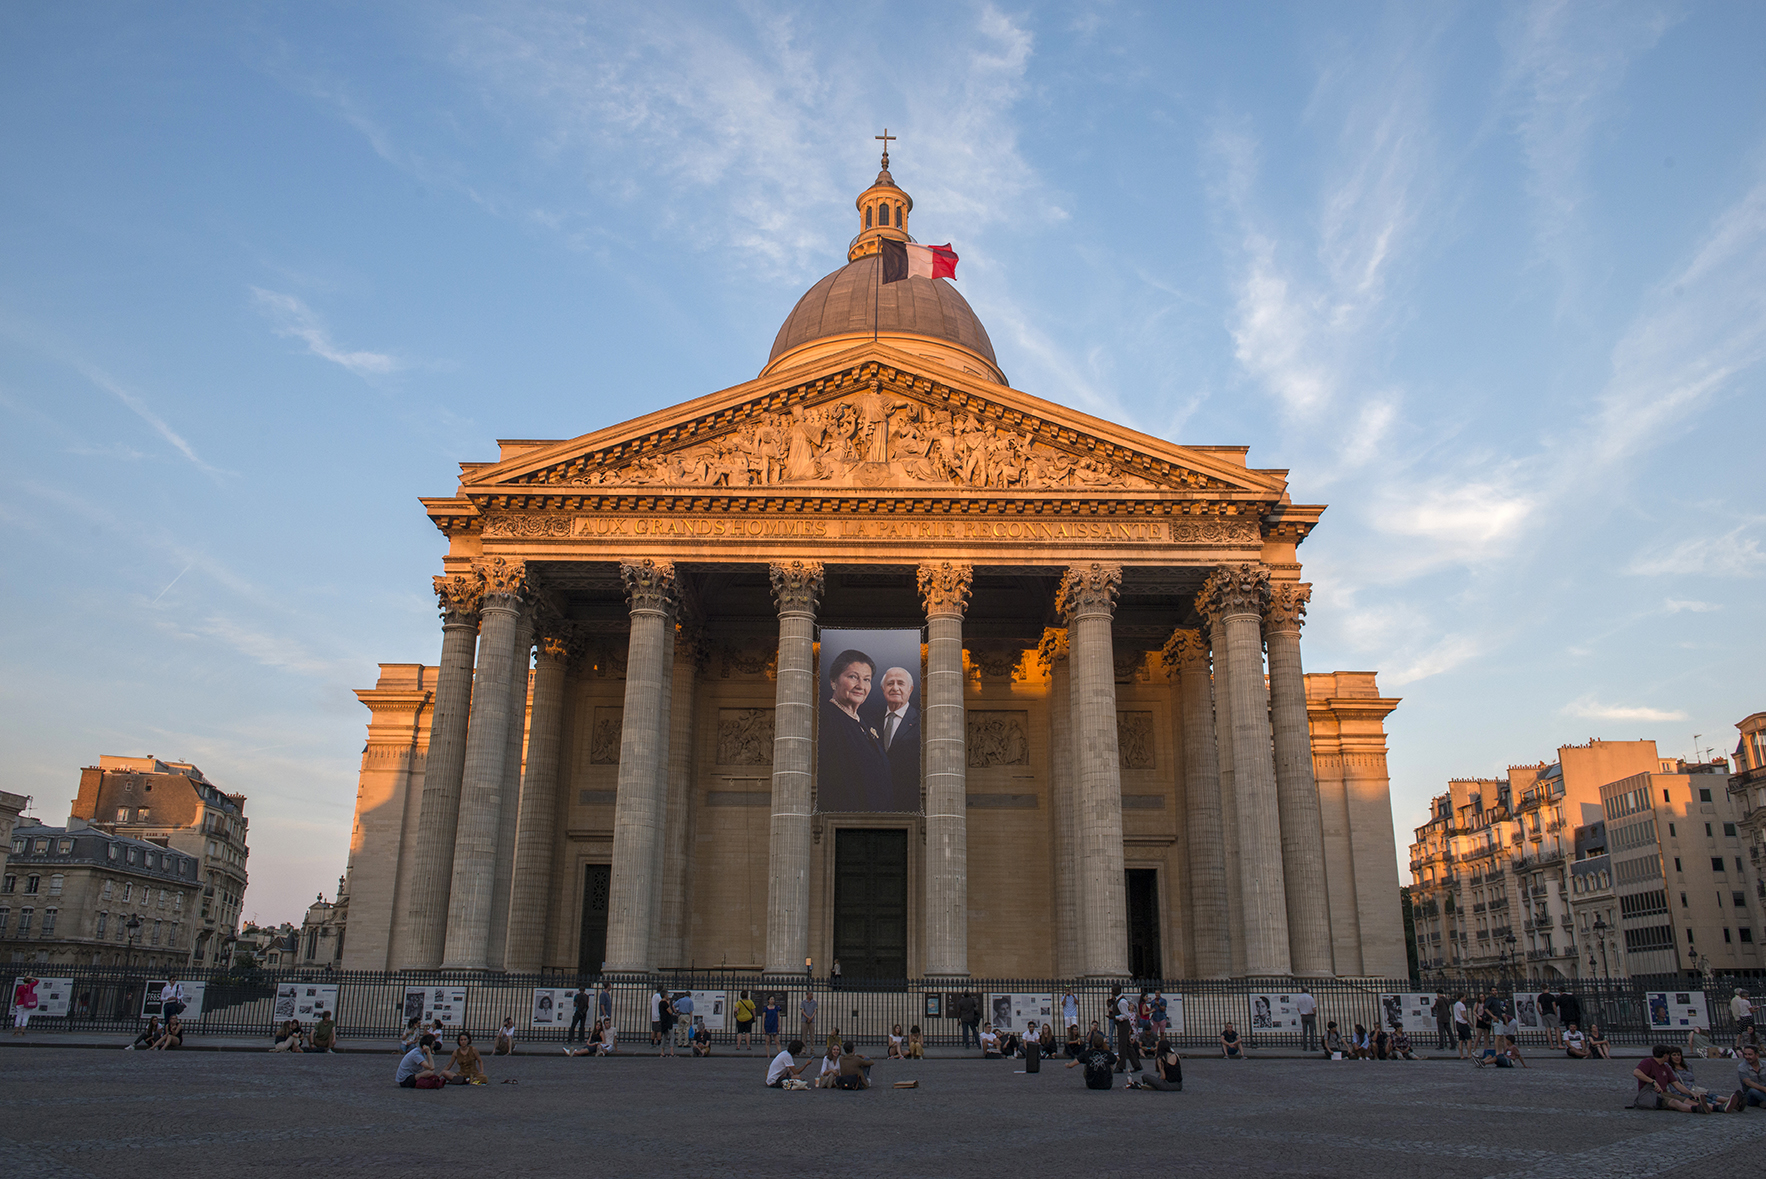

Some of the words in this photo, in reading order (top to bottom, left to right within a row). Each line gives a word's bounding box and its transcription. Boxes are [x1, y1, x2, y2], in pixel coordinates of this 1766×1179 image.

[579, 519, 628, 534] AUX
[634, 519, 726, 535] GRANDS
[730, 520, 828, 536] HOMMES
[840, 521, 870, 537] LA
[875, 521, 956, 538] PATRIE
[963, 522, 1162, 539] RECONNAISSANTE
